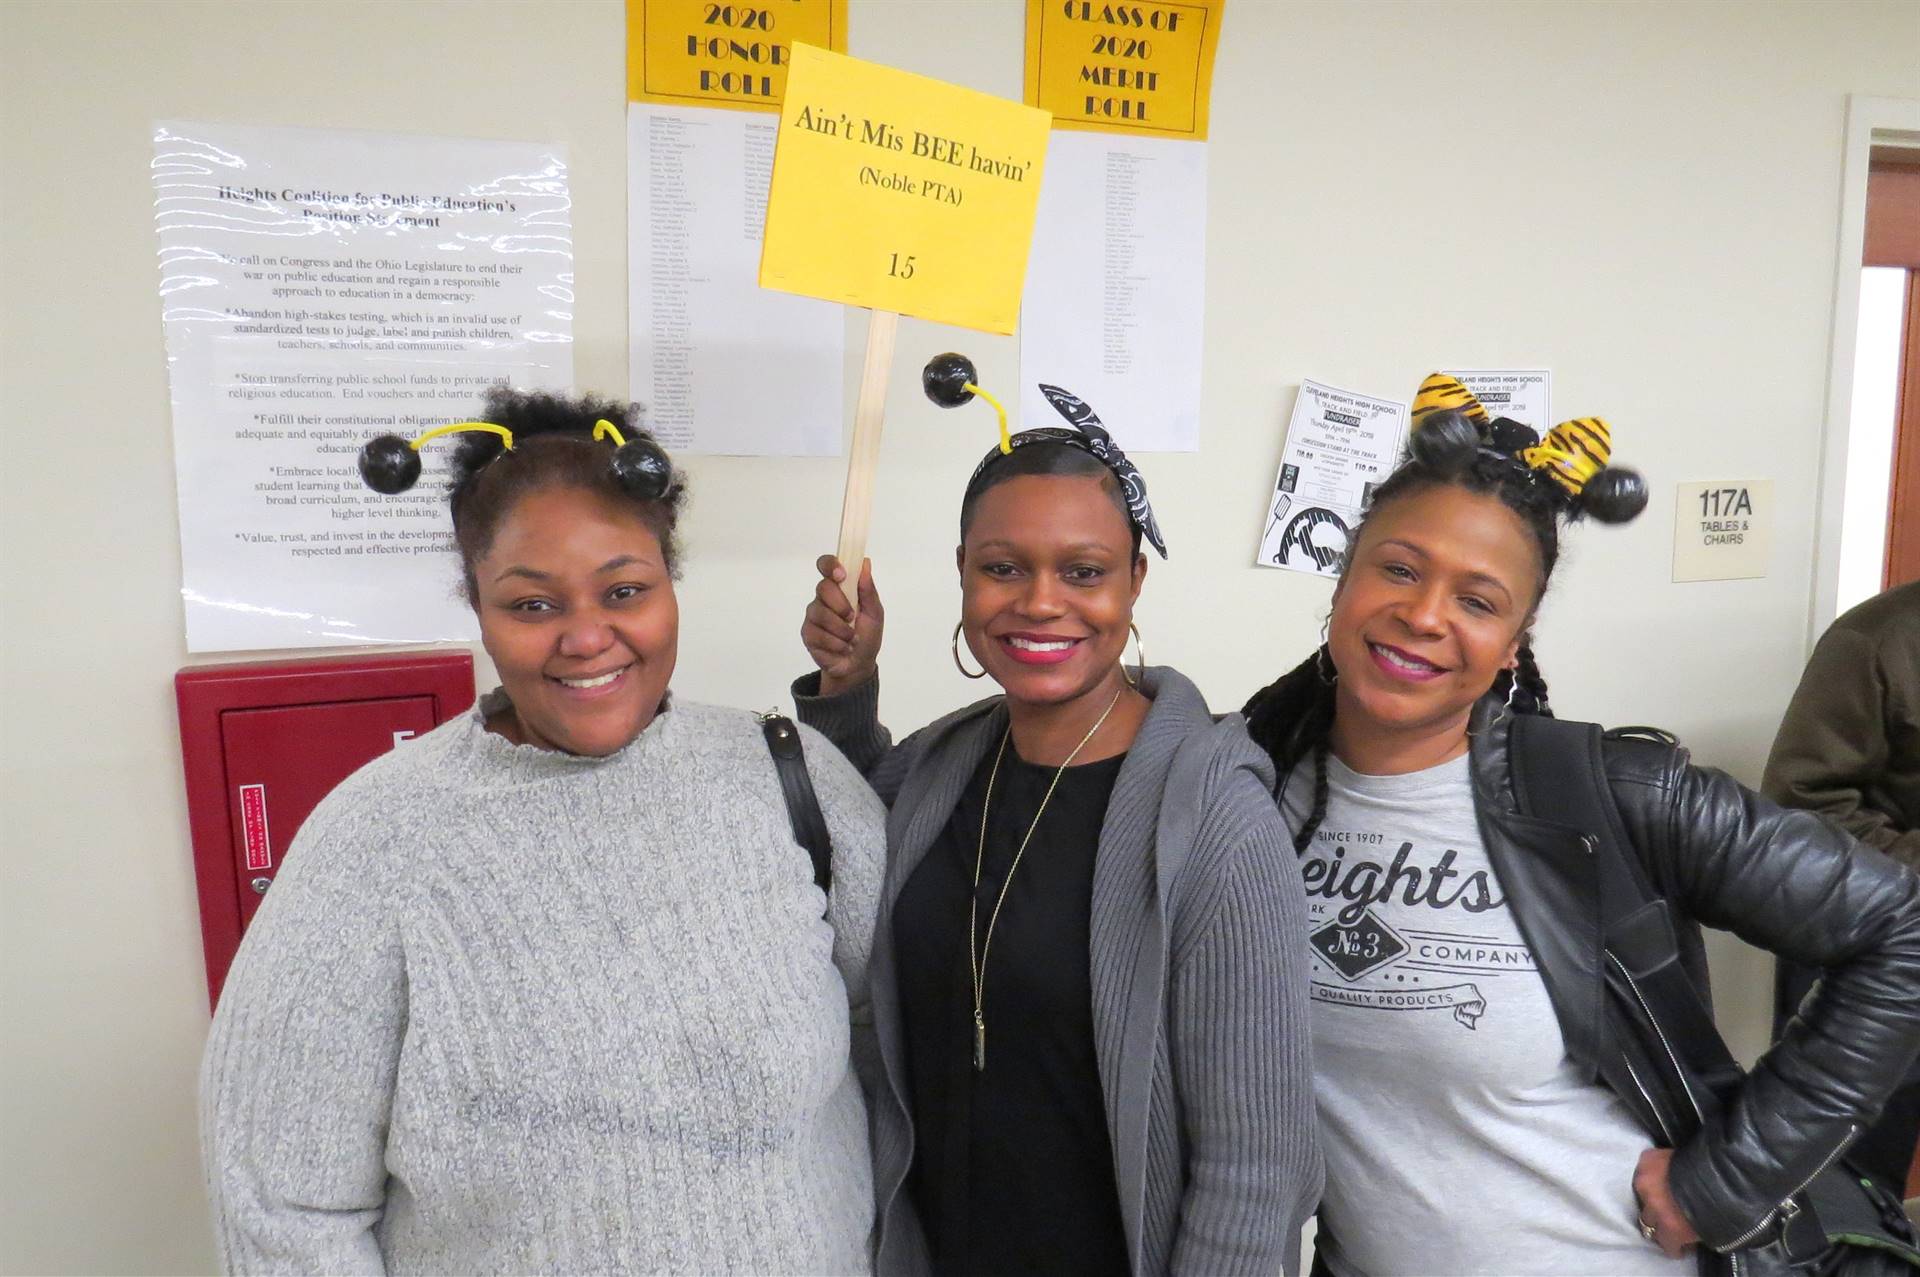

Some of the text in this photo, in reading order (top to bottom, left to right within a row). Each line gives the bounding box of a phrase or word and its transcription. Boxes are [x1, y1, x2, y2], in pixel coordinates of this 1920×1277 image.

[703, 3, 776, 32] 2020
[1063, 0, 1184, 32] CLASS OF
[687, 34, 791, 66] HONOR
[1092, 34, 1152, 60] 2020
[700, 70, 778, 98] ROLL
[1078, 64, 1160, 91] MERIT
[1085, 96, 1151, 121] ROLL
[794, 104, 854, 141] Ain't
[860, 119, 904, 151] Mis
[911, 131, 964, 167] BEE
[219, 186, 277, 203] Heights
[282, 188, 350, 203] Coalition
[859, 166, 963, 207] (Noble PTA)
[240, 255, 260, 265] call
[263, 257, 277, 266] on
[280, 256, 330, 269] Congress
[333, 258, 353, 268] and
[356, 259, 373, 269] the
[375, 260, 401, 270] Ohio
[405, 260, 463, 273] Legislature
[465, 263, 476, 272] to
[478, 263, 497, 273] end
[499, 264, 523, 274] their
[888, 252, 916, 280] 15
[243, 271, 263, 280] war
[267, 272, 280, 281] on
[284, 272, 318, 283] public
[321, 272, 375, 284] education
[376, 275, 395, 285] and
[398, 277, 431, 287] regain
[442, 277, 501, 289] responsible
[272, 286, 322, 298] approach
[325, 288, 336, 297] to
[338, 288, 390, 299] education
[393, 290, 403, 299] in
[284, 309, 346, 321] high-stakes
[391, 312, 422, 323] which
[426, 313, 435, 323] is
[453, 315, 488, 324] invalid
[490, 317, 507, 325] use
[510, 315, 522, 325] of
[233, 323, 303, 335] standardized
[306, 325, 330, 335] tests
[333, 326, 343, 336] to
[411, 327, 430, 337] and
[432, 328, 466, 339] punish
[375, 341, 394, 351] and
[270, 374, 333, 386] transferring
[336, 374, 369, 386] public
[372, 375, 407, 385] school
[410, 375, 439, 385] funds
[441, 376, 451, 385] to
[454, 375, 489, 387] private
[492, 375, 511, 385] and
[228, 388, 276, 400] religious
[342, 388, 364, 399] End
[367, 388, 414, 399] vouchers
[416, 389, 435, 399] and
[438, 388, 473, 399] charter
[297, 414, 321, 425] their
[324, 415, 396, 425] constitutional
[399, 415, 451, 427] obligation
[235, 429, 284, 441] adequate
[287, 430, 307, 439] and
[310, 429, 359, 441] equitably
[255, 481, 363, 492] student learning that
[266, 495, 297, 505] broad
[364, 495, 382, 504] and
[385, 496, 438, 506] encourage
[1699, 488, 1752, 517] 117A
[331, 508, 364, 520] higher
[368, 508, 393, 518] level
[1701, 520, 1749, 532] TABLES &
[310, 532, 329, 542] and
[333, 531, 363, 541] invest
[367, 531, 377, 540] in
[380, 530, 396, 540] the
[1703, 533, 1744, 545] CHAIRS
[291, 545, 341, 558] respected
[344, 545, 364, 554] and
[366, 544, 411, 554] effective
[1318, 831, 1384, 845] SINCE 1907
[1302, 842, 1506, 925] eights
[1419, 945, 1533, 964] COMPANY
[1319, 988, 1454, 1006] QUALITY PRODUCTS
